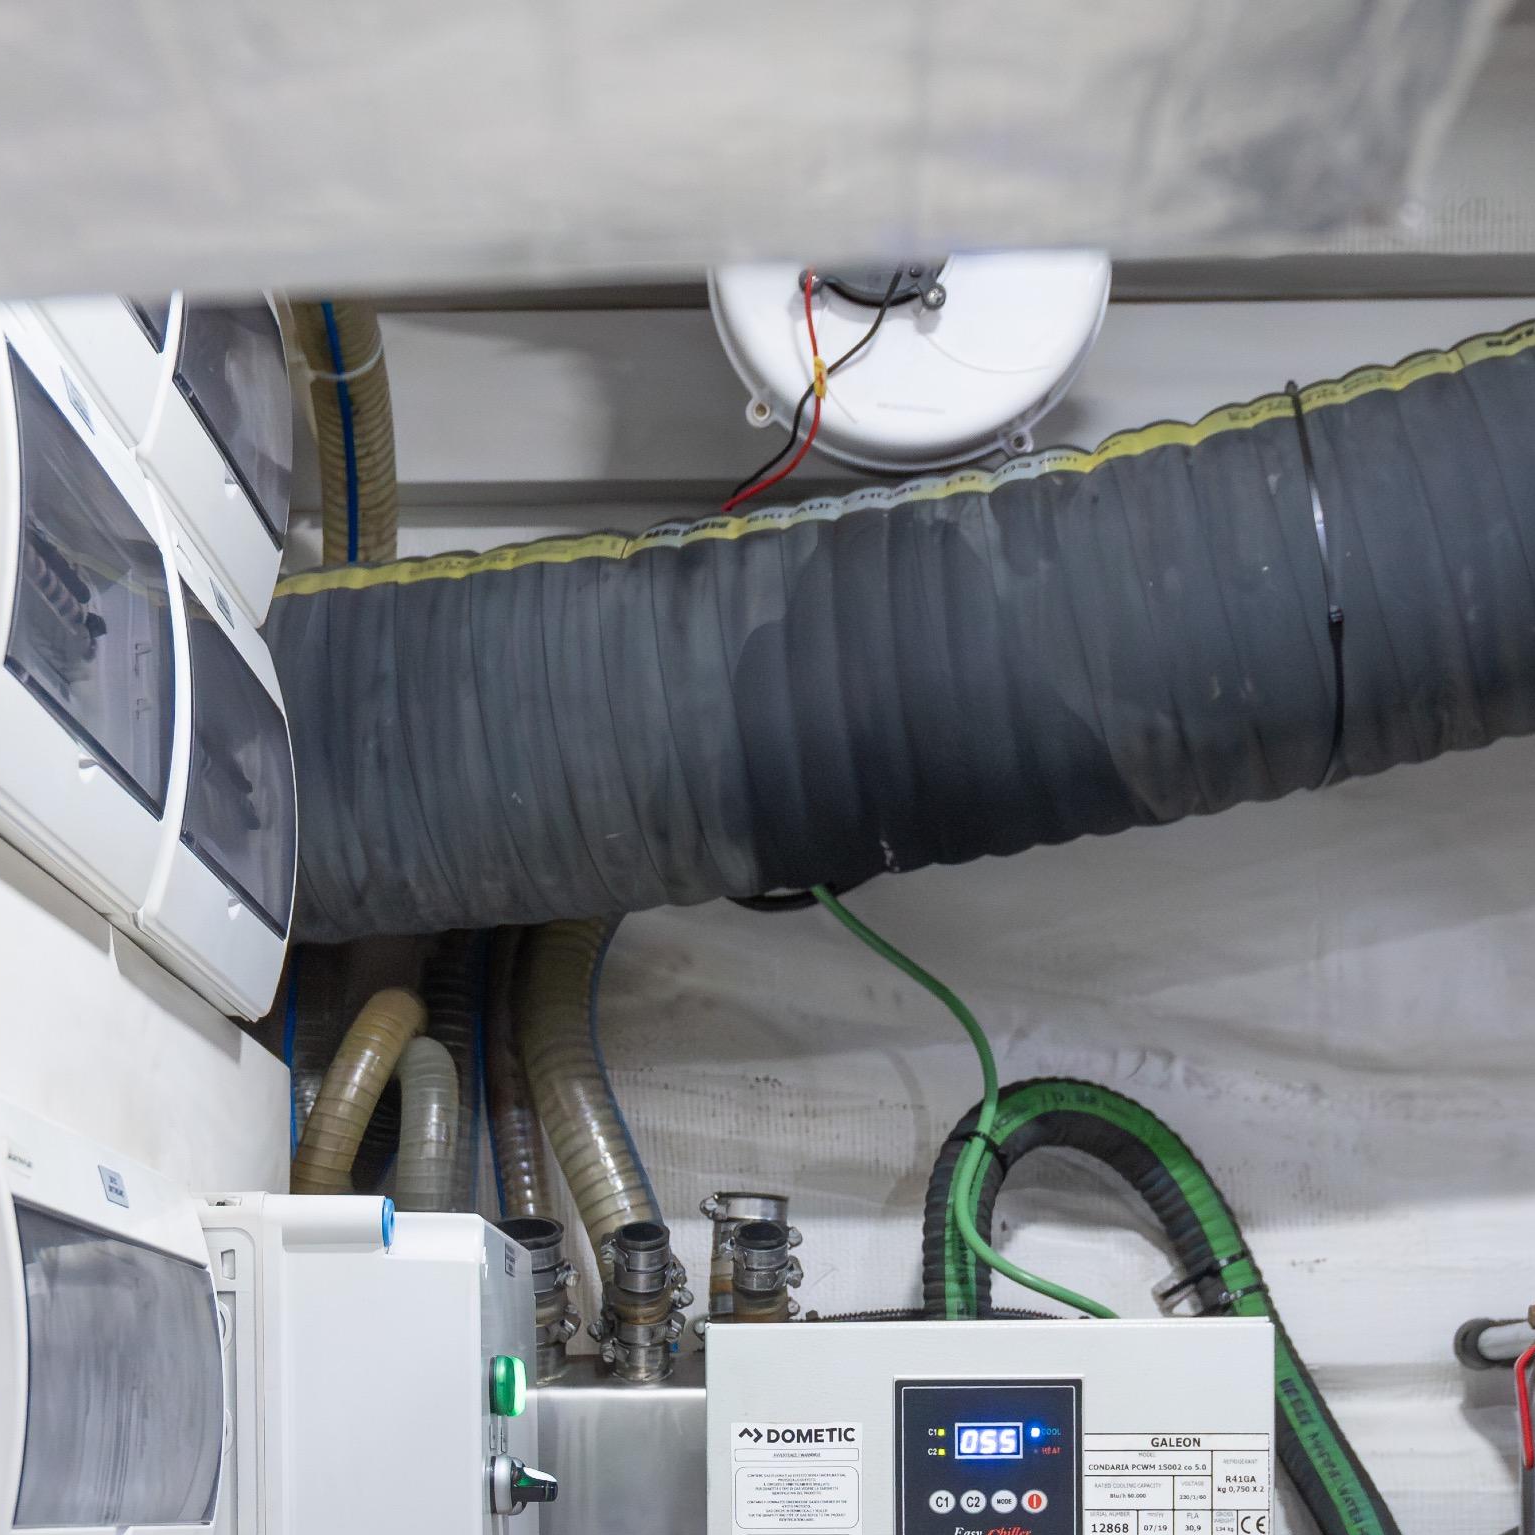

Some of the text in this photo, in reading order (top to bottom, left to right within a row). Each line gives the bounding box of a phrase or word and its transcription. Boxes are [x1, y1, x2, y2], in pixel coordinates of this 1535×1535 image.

[767, 1428, 855, 1443] DOMETIC
[1042, 1428, 1061, 1436] COOL
[1151, 1438, 1201, 1448] GALEON
[1041, 1447, 1061, 1455] HEAT
[1217, 1486, 1226, 1494] kg
[936, 1496, 950, 1508] C1
[966, 1496, 980, 1508] C2
[1091, 1523, 1129, 1533] 12868
[1143, 1525, 1168, 1533] 07/19
